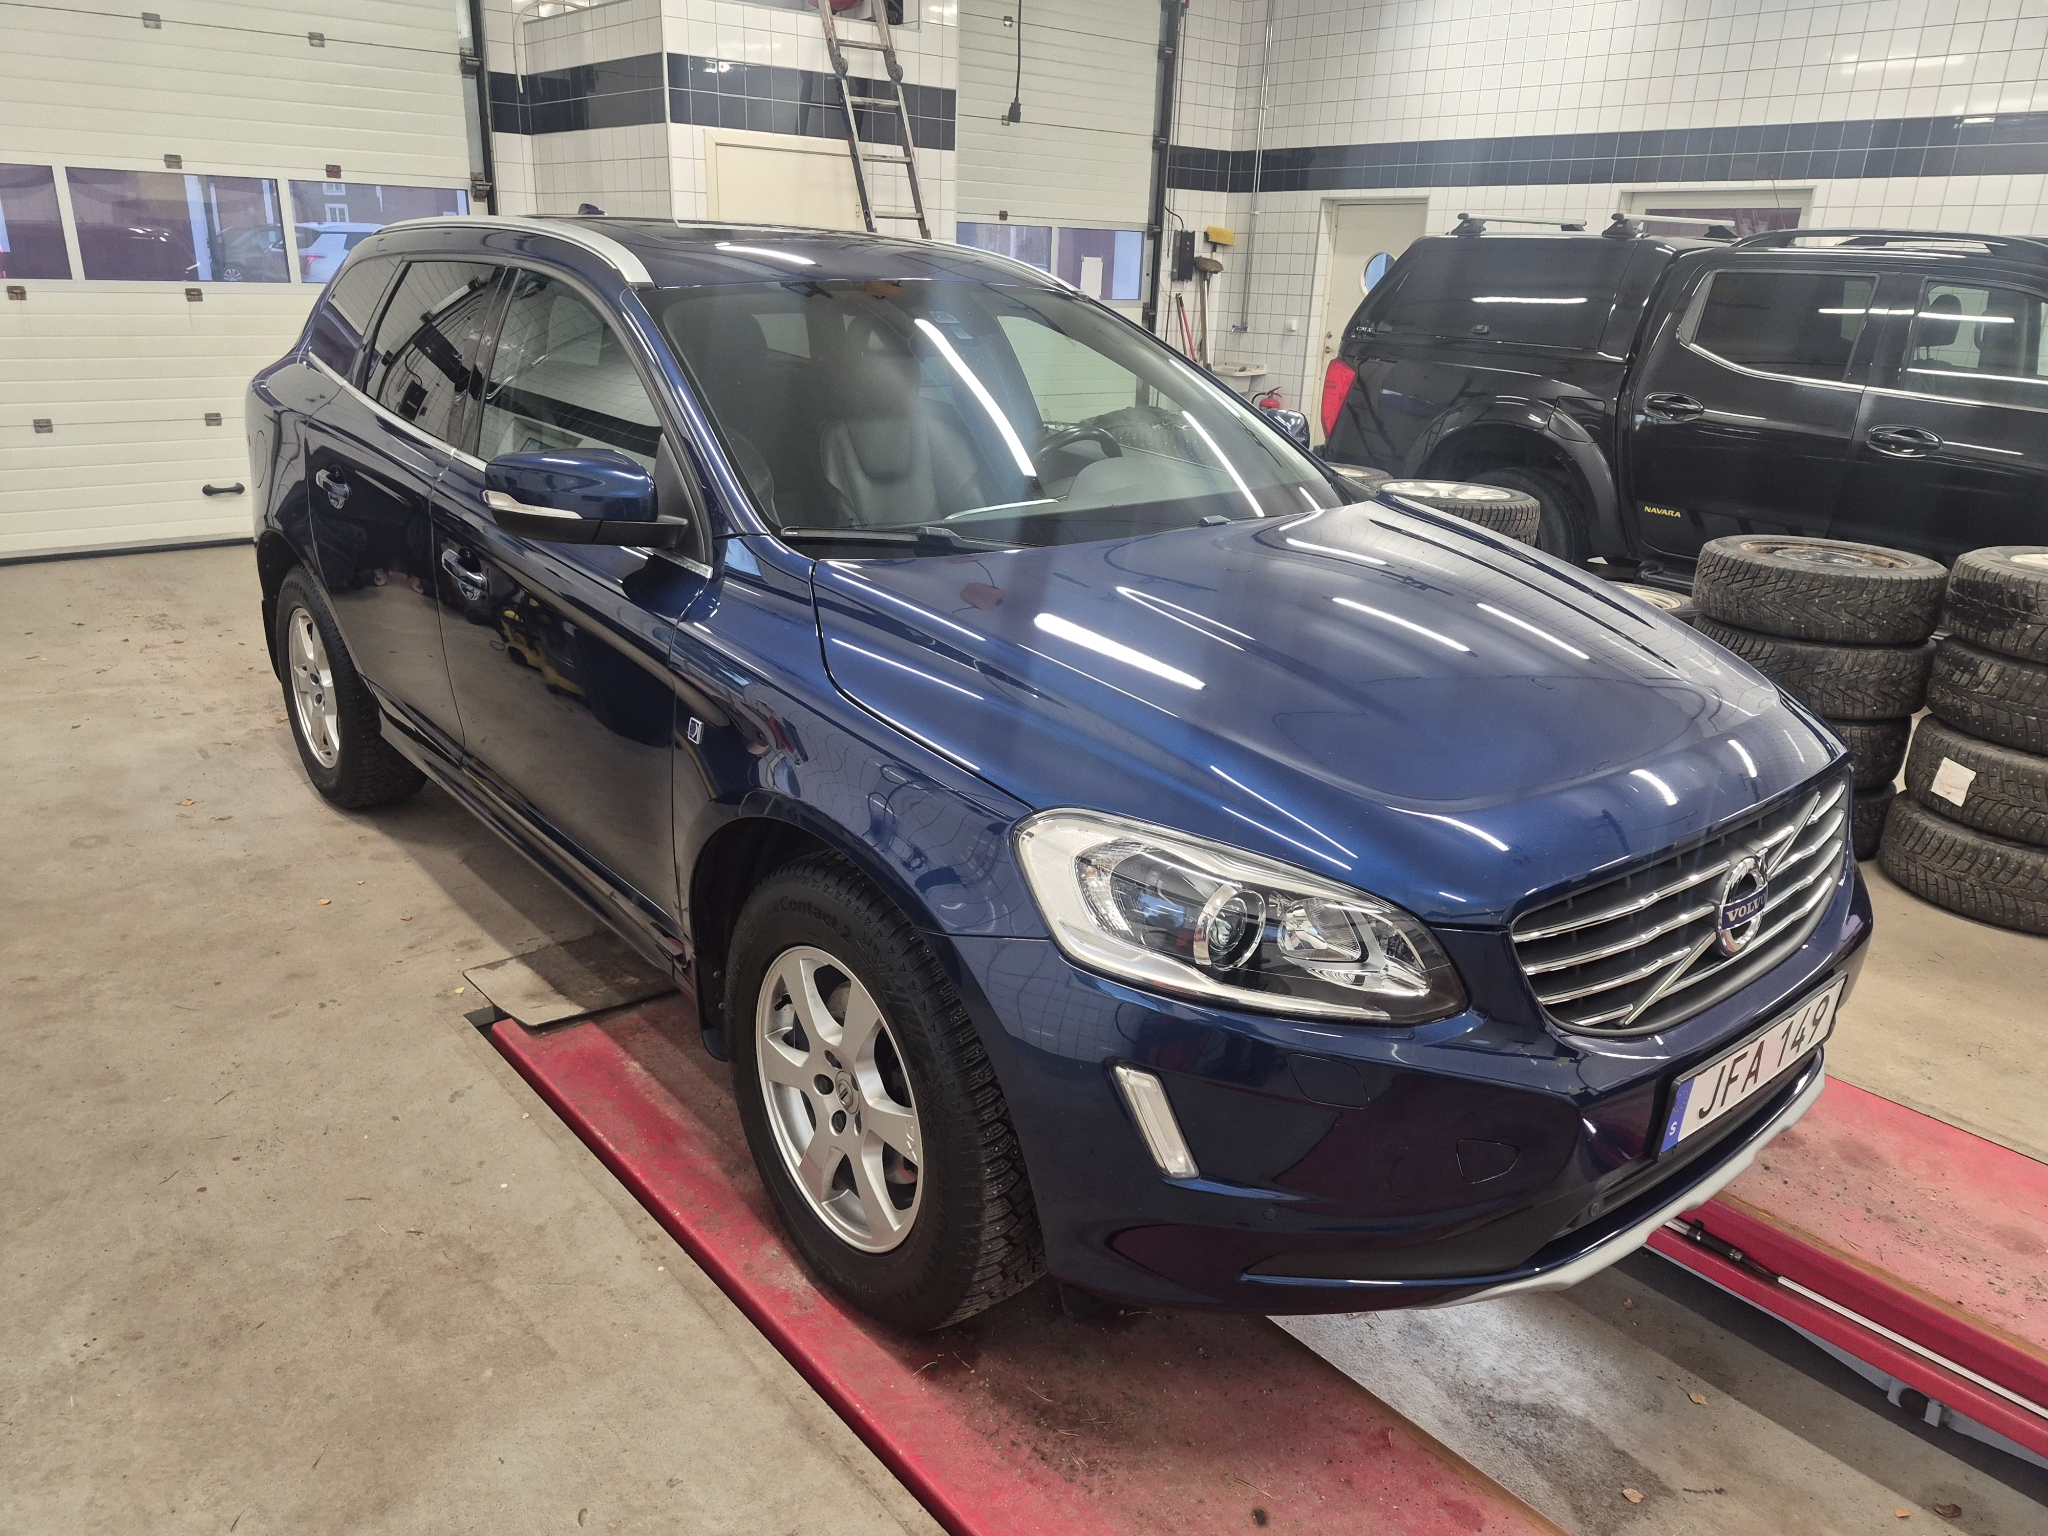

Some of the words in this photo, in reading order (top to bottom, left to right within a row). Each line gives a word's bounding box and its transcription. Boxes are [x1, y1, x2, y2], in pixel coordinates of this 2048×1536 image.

[1643, 505, 1681, 518] NAVARA
[1698, 1039, 1765, 1120] JFA
[1777, 994, 1830, 1067] 149
[1669, 1121, 1678, 1136] S
